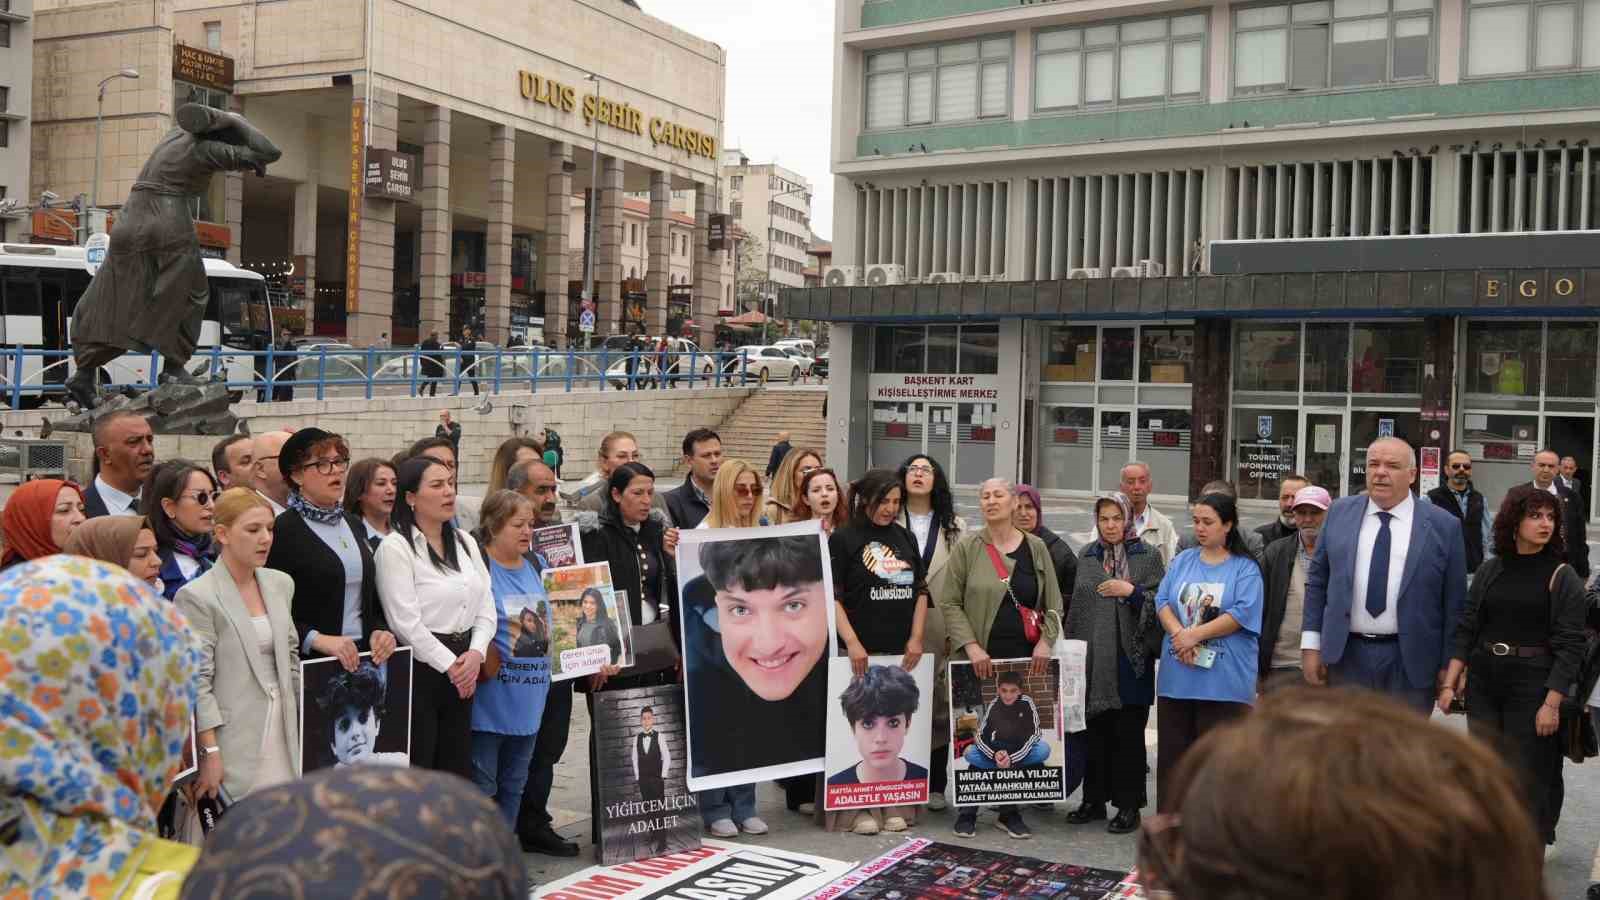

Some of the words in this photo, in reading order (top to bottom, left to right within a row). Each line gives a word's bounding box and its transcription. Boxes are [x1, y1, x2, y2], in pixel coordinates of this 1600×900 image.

[520, 70, 576, 112] ULUS
[583, 94, 643, 135] ŞEHİR
[650, 117, 718, 160] ÇARŞISI
[904, 376, 946, 386] BAŞKENT
[950, 376, 974, 386] KART
[878, 386, 956, 399] KİŞİSELLEŞTİRME
[1248, 454, 1280, 462] TOURIST
[1238, 462, 1291, 470] INFORMATION
[1249, 471, 1278, 479] OFFICE
[959, 771, 994, 782] MURAT
[996, 770, 1025, 780] DUHA
[1026, 768, 1058, 778] YILDIZ
[959, 782, 992, 792] YATAĞA
[994, 781, 1034, 790] MAHKUM
[1034, 780, 1060, 789] KALDI
[834, 794, 880, 804] ADALETLE
[882, 790, 920, 802] YAŞASIN
[958, 794, 986, 802] ADALET
[988, 792, 1022, 800] MAHKUM
[1023, 791, 1062, 800] KALMASIN
[606, 797, 668, 818] YİĞİTCEM
[672, 793, 696, 810] İÇİN
[628, 816, 679, 834] ADALET
